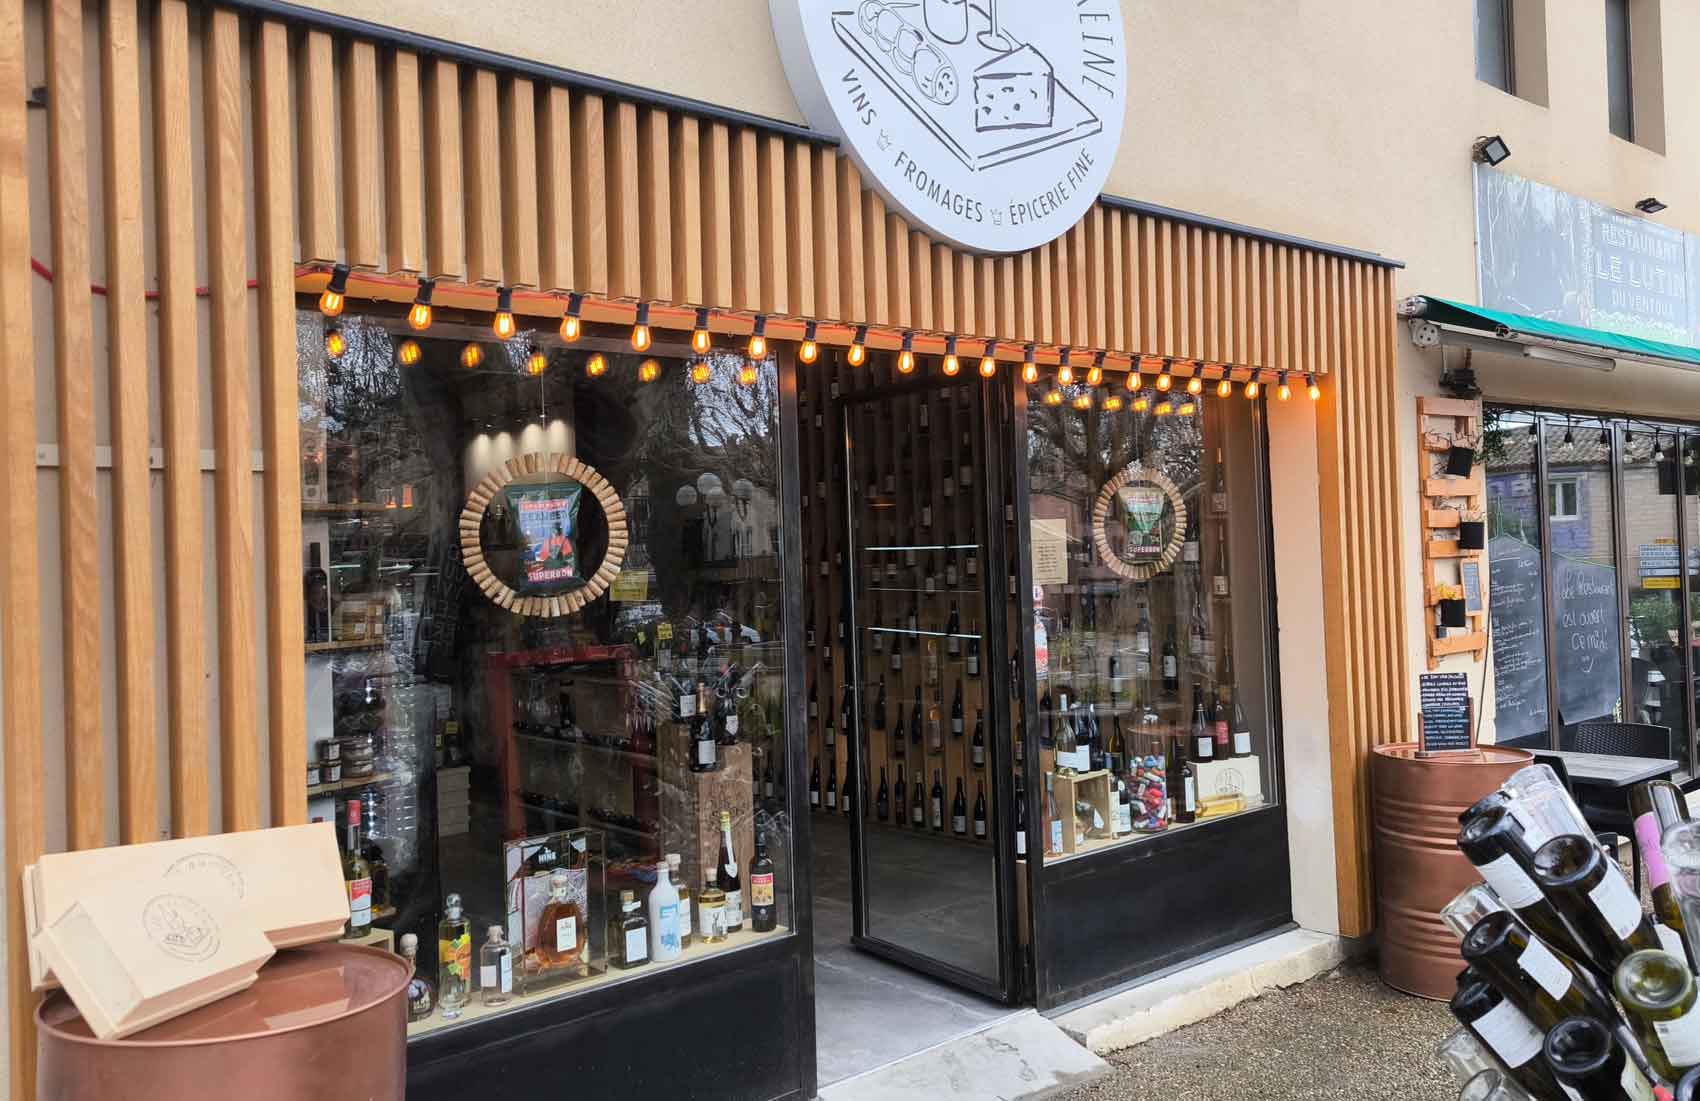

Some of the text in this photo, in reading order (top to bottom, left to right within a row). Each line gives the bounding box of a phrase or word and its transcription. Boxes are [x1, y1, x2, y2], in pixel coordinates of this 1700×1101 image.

[1077, 0, 1115, 99] EINE
[841, 68, 1095, 226] VINS FROMAGES ÉPICERIE FINE
